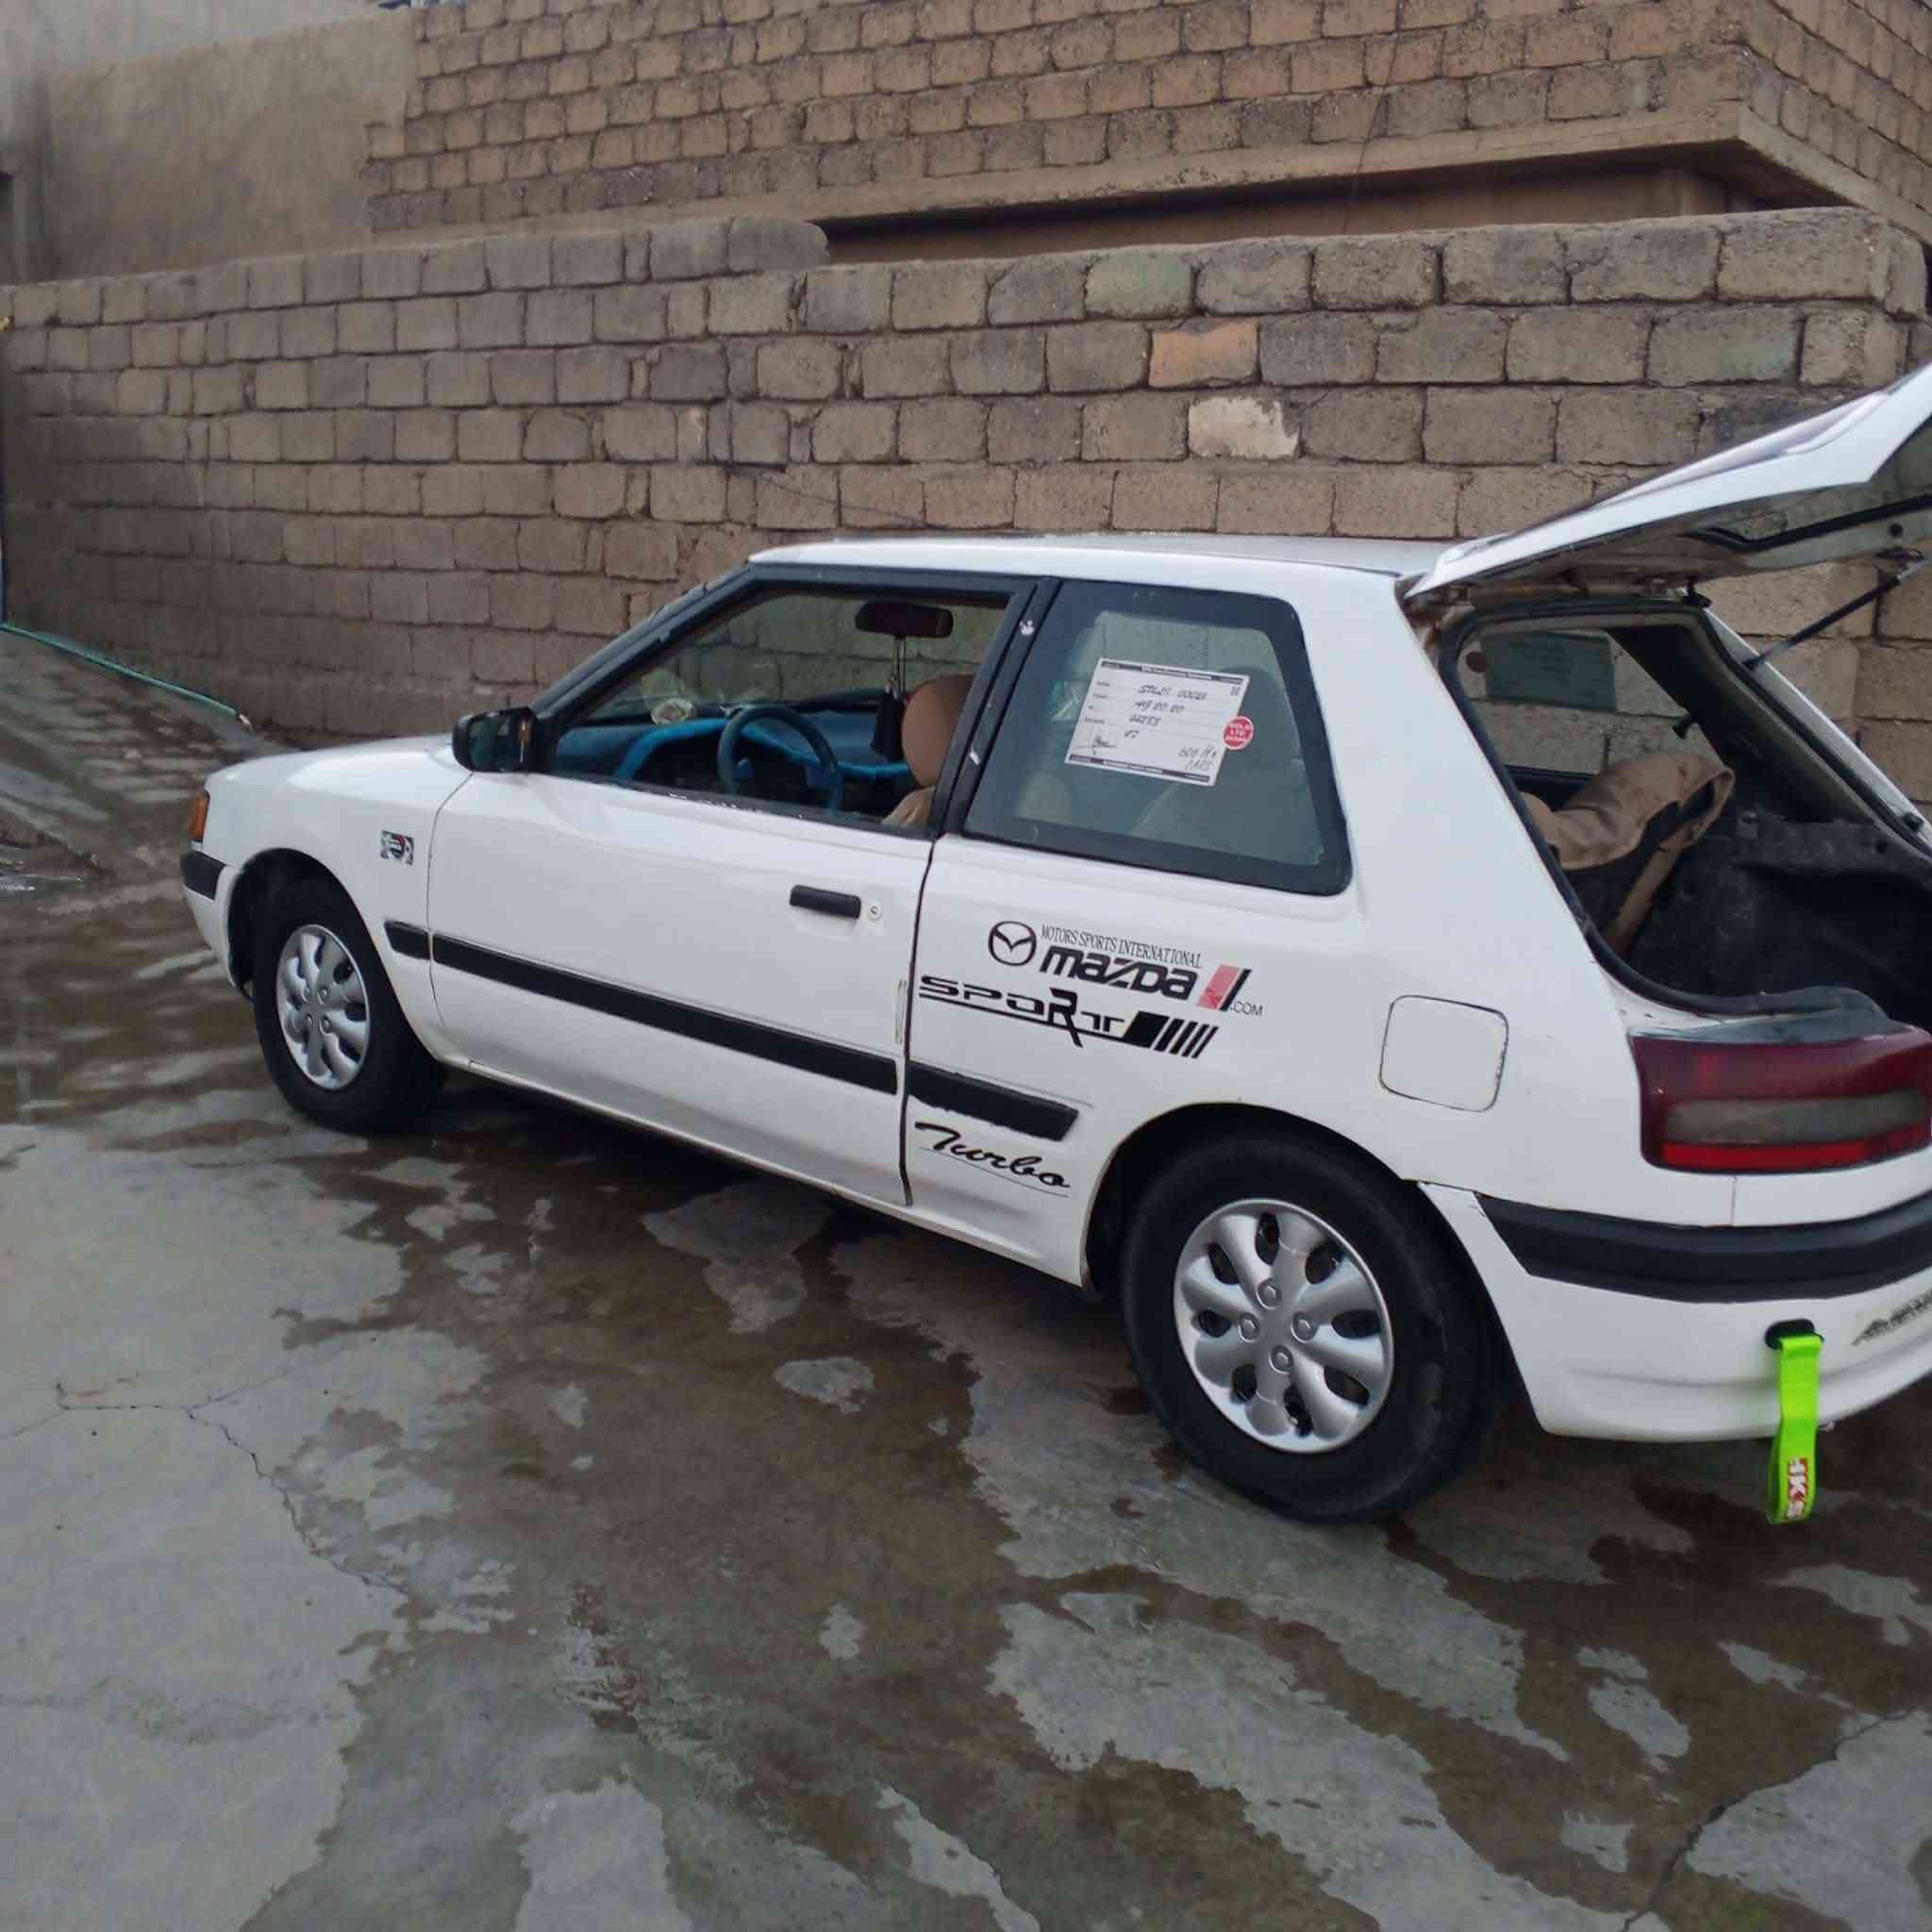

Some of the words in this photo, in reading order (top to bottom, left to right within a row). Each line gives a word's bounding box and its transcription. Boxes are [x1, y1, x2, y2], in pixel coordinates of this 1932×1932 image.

[1041, 924, 1078, 944] MOTORS
[1079, 931, 1117, 953] SPORTS
[1118, 939, 1203, 969] INTERNATIONAL
[915, 1122, 1071, 1188] Turbo
